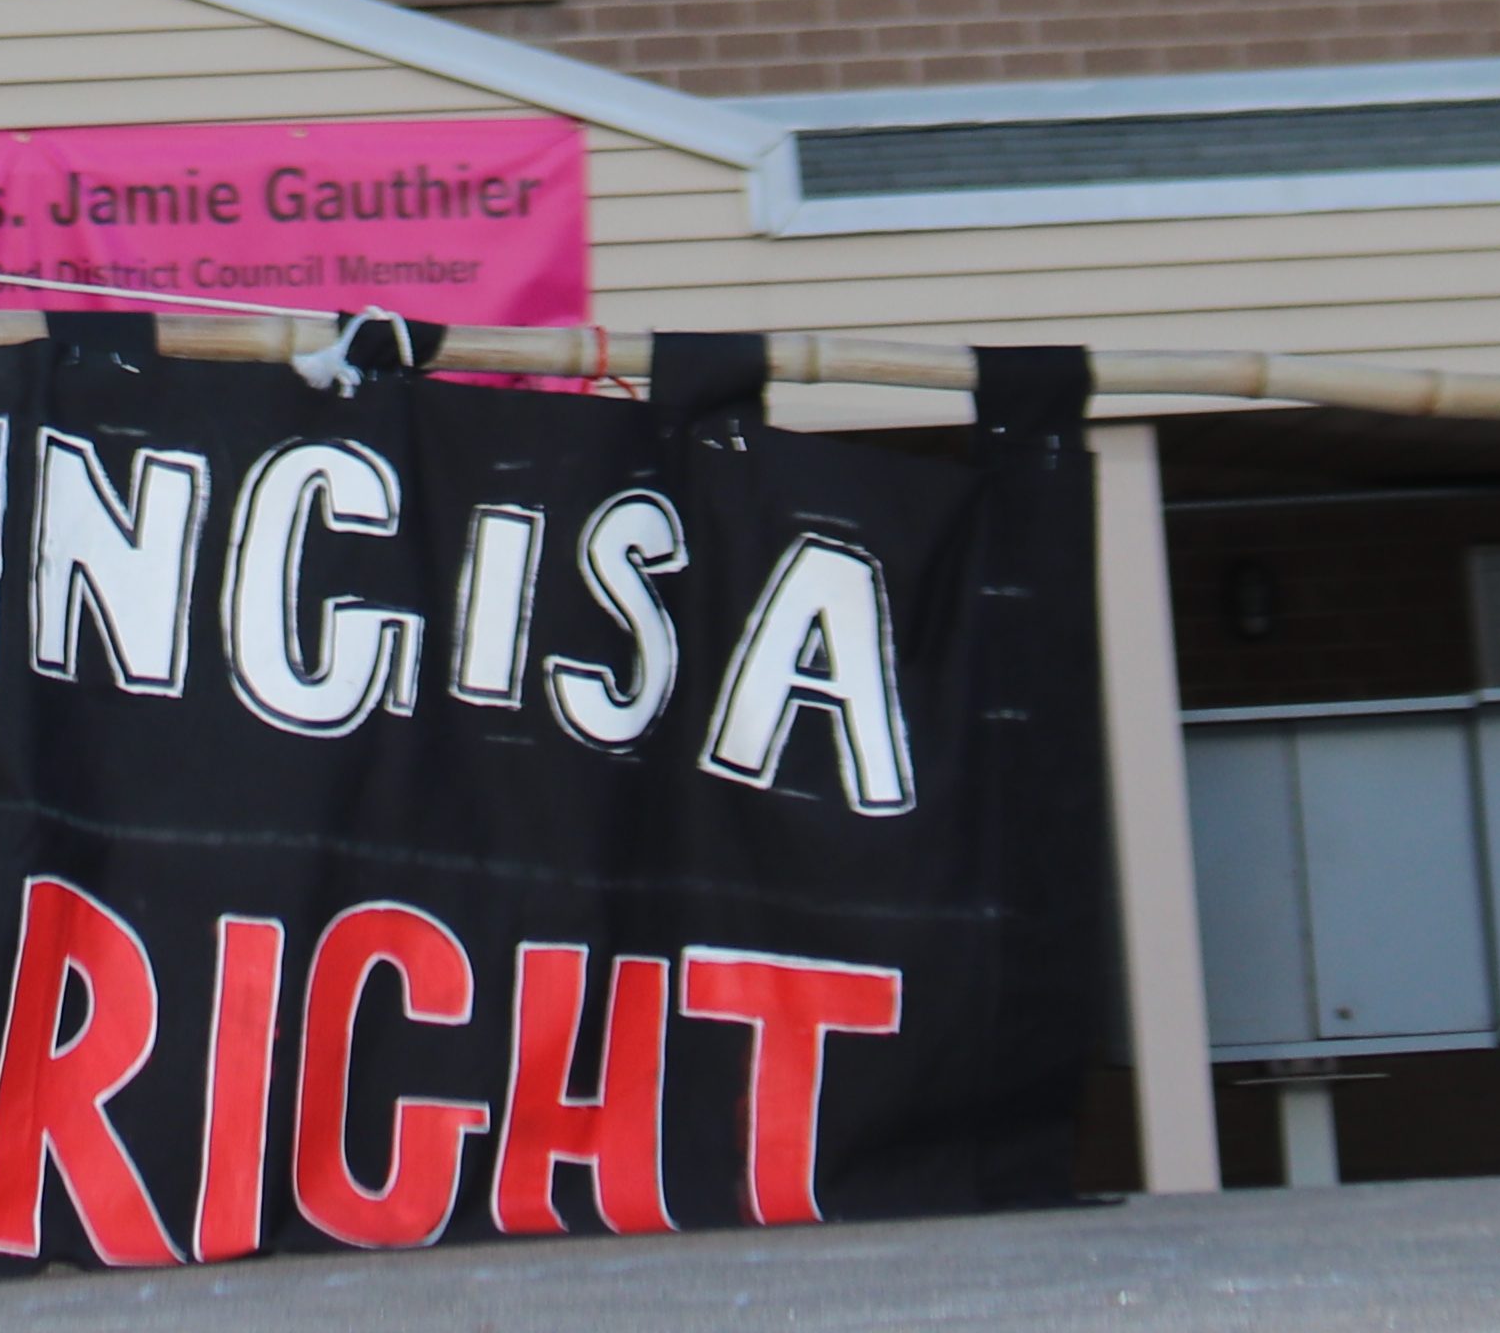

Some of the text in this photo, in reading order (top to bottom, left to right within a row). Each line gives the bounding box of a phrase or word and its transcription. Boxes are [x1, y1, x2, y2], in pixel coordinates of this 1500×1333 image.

[50, 169, 241, 227] Jamie
[264, 164, 541, 223] Gauthier
[191, 256, 323, 289] Council
[337, 253, 480, 285] Member
[699, 531, 915, 817] A
